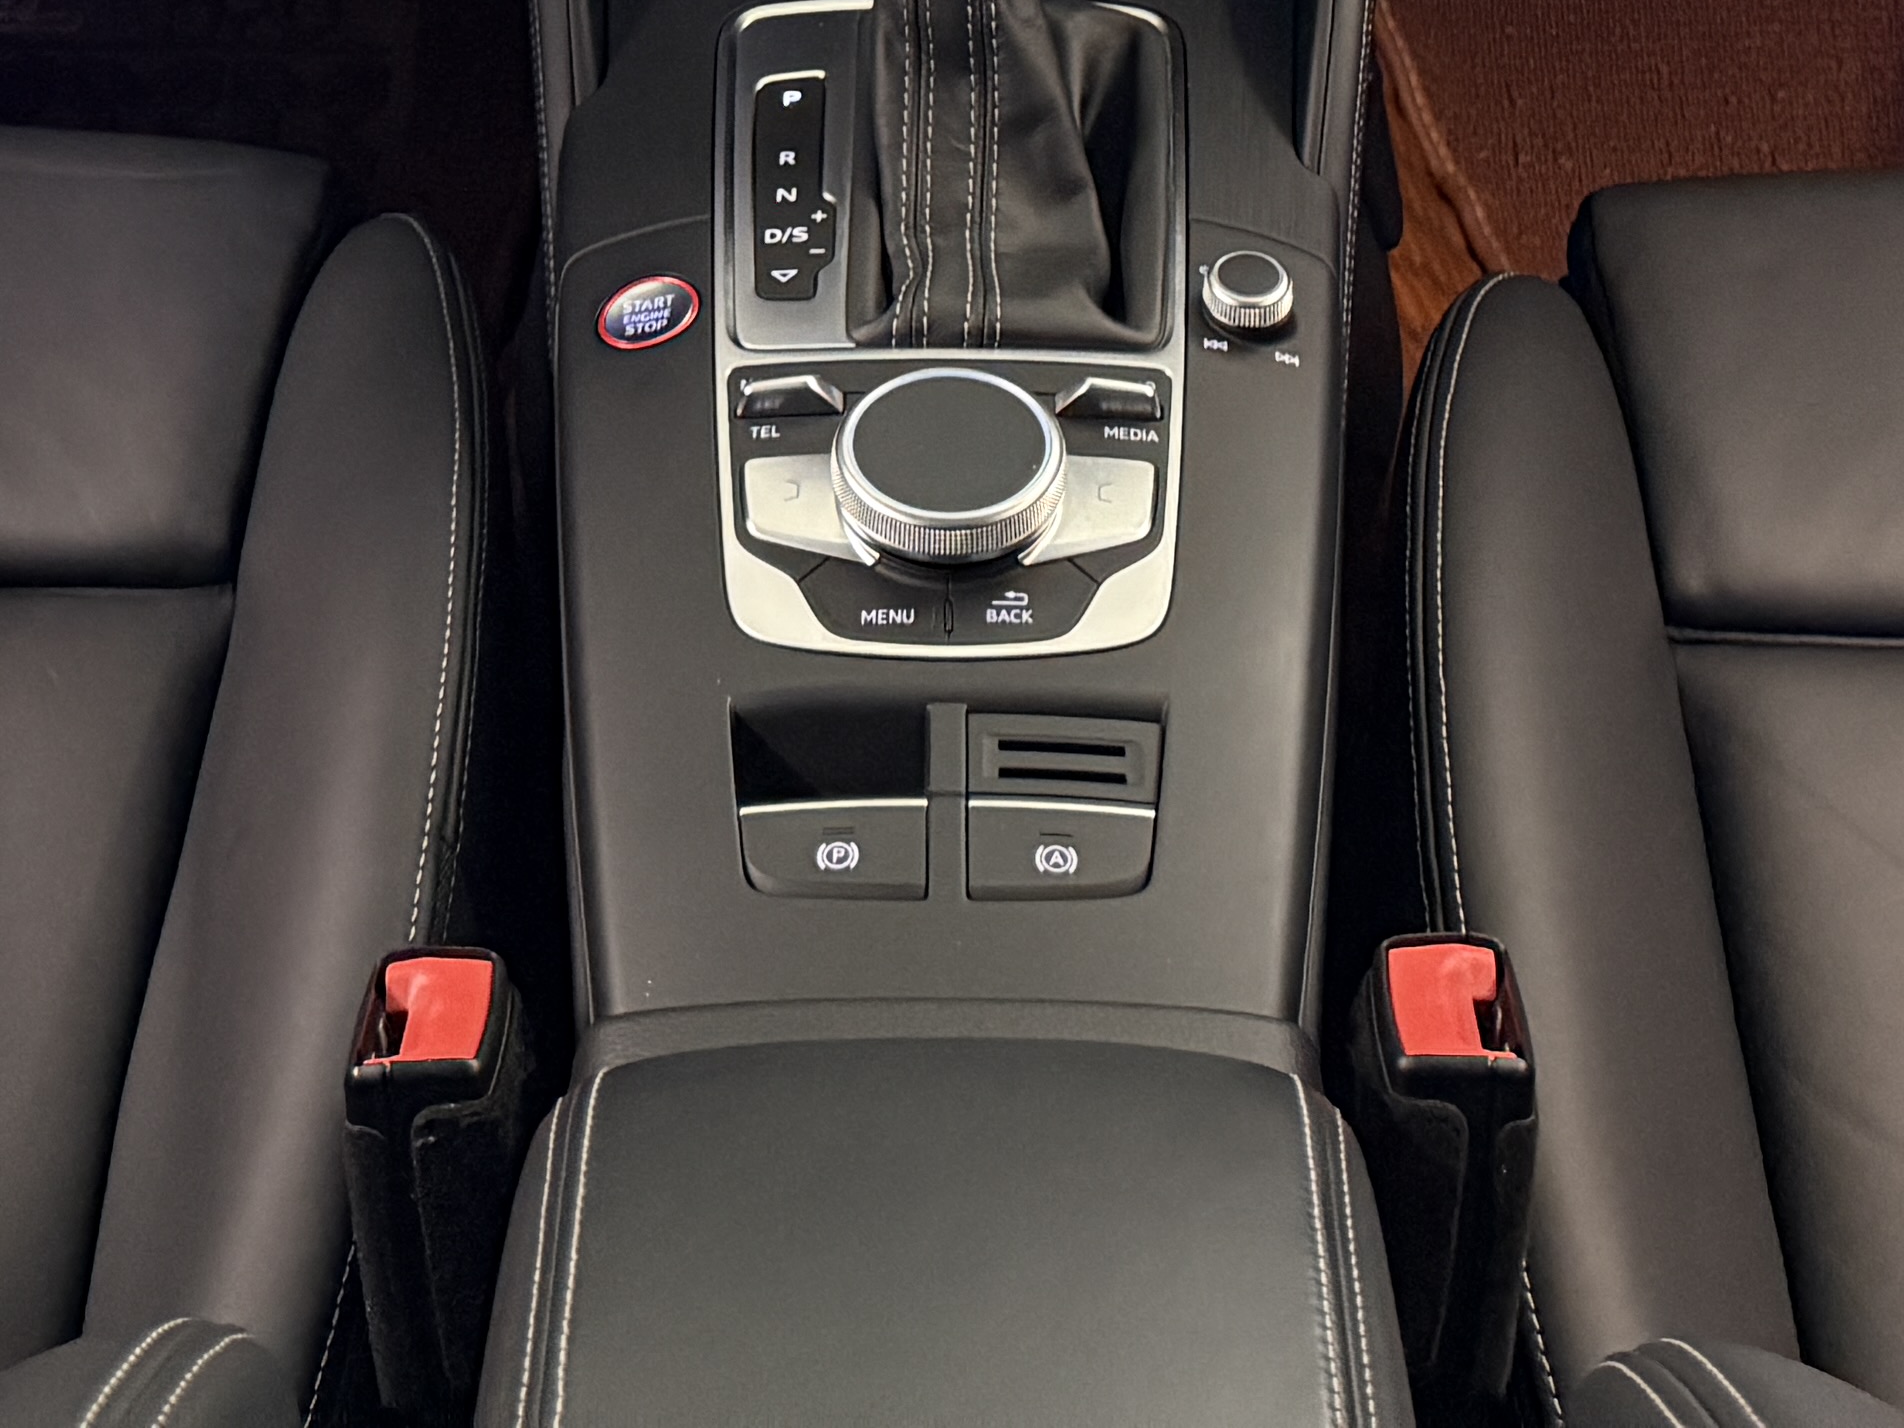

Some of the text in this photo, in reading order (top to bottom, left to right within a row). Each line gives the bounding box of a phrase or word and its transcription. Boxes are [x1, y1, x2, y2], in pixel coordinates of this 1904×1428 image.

[782, 90, 802, 107] P
[779, 150, 797, 166] R
[776, 187, 798, 203] N
[763, 226, 809, 244] D/S
[622, 294, 676, 314] START
[622, 308, 672, 325] ENGINE
[624, 318, 668, 337] STOP
[750, 425, 781, 440] TEL
[1103, 425, 1159, 443] MEDIA
[860, 608, 915, 626] MENU
[985, 608, 1034, 625] BACK
